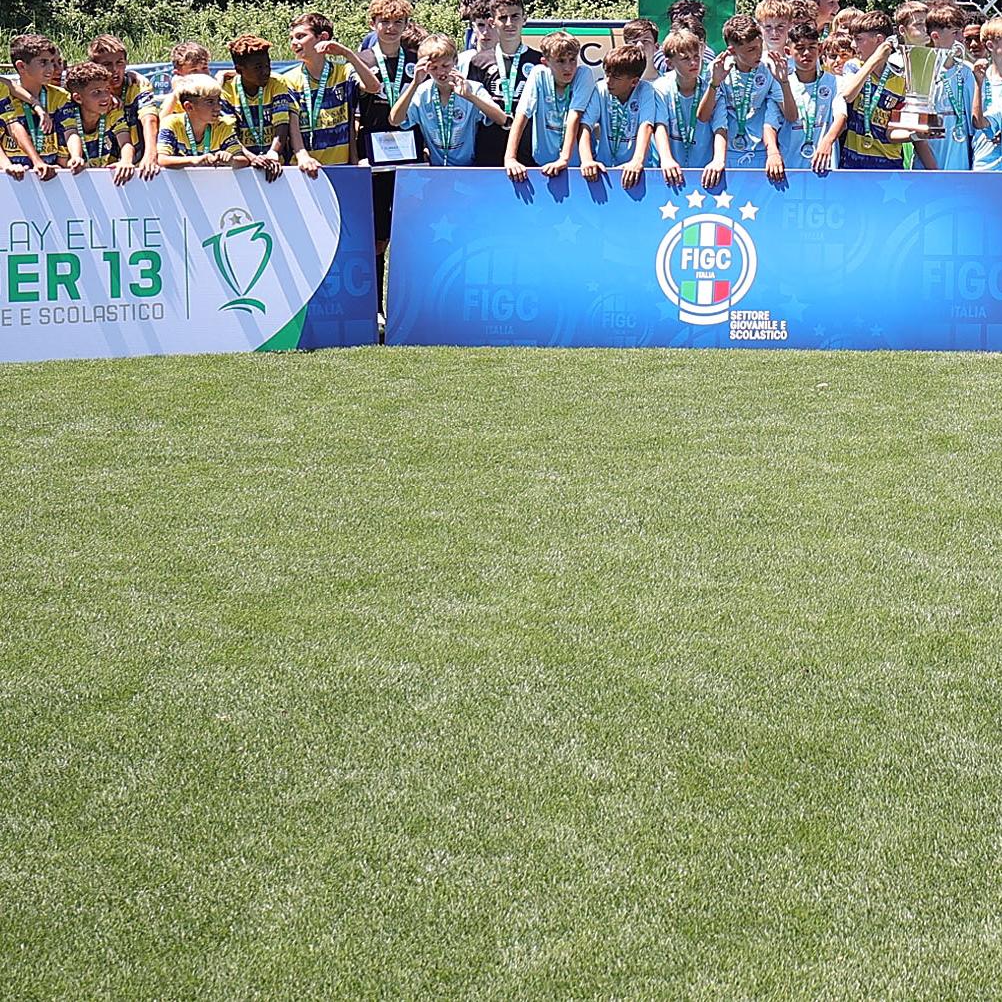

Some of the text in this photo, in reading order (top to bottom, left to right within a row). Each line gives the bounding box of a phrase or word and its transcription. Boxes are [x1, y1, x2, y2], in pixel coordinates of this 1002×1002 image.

[0, 217, 162, 252] AY ELITE
[681, 247, 732, 270] FIGC
[7, 250, 163, 303] ER 13
[695, 271, 716, 279] ITALIA
[20, 307, 32, 326] E
[39, 303, 165, 325] SCOLASTICO
[464, 288, 539, 322] FIGC
[730, 310, 770, 321] SETTORE
[729, 320, 787, 330] GIOVANILE E
[729, 330, 788, 340] SCOLASTICO
